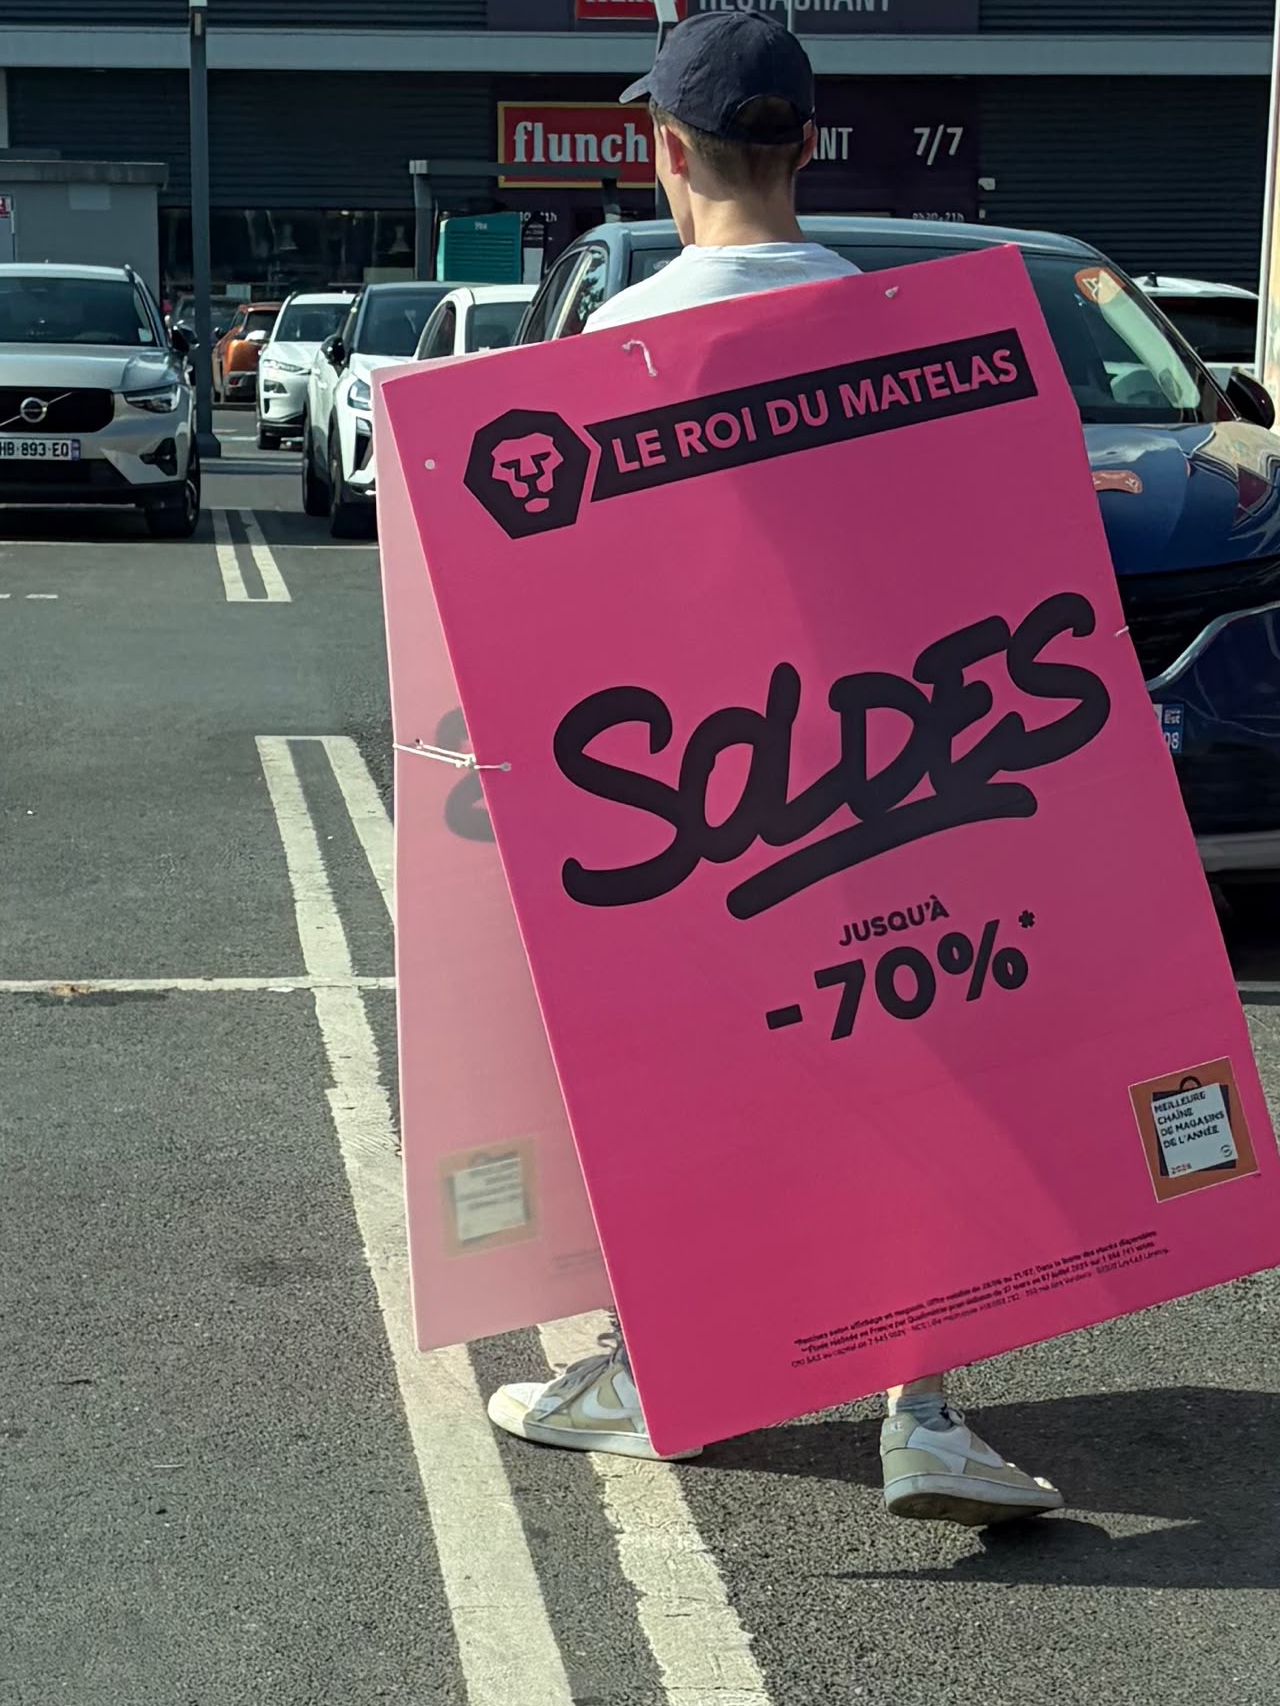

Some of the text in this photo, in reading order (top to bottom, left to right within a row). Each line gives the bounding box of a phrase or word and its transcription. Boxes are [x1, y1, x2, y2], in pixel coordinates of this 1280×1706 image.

[513, 121, 650, 163] flunch
[913, 124, 964, 165] 7/7
[612, 348, 1018, 474] LE ROI DU MATELAS
[553, 592, 1111, 908] SOLDES
[839, 894, 950, 947] JUSQU'À
[1154, 1091, 1206, 1113] MEILLEURE
[1160, 1111, 1225, 1137] DE MAGASINS
[1163, 1125, 1220, 1149] DE L'ANNÉE
